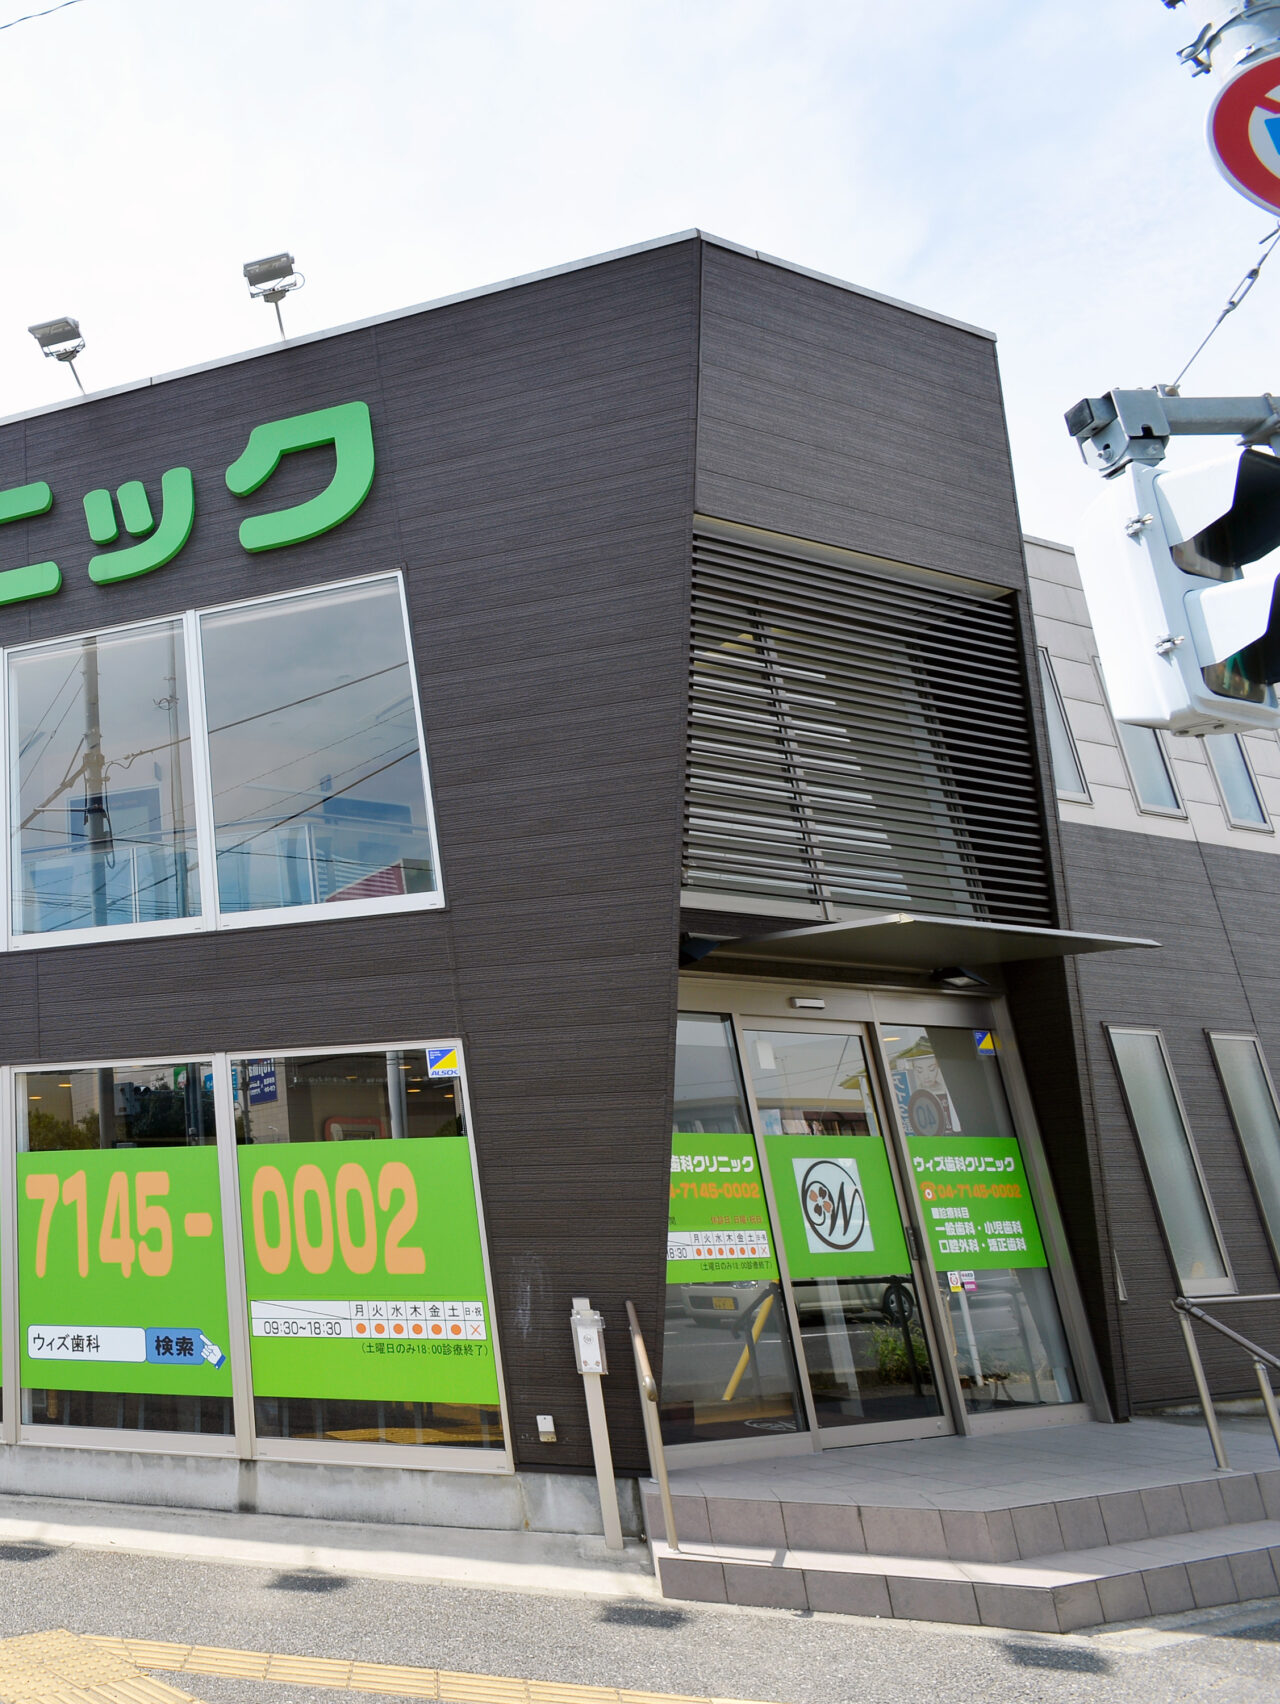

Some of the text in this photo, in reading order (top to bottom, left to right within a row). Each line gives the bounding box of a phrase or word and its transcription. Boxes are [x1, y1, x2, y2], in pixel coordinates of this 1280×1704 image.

[913, 1156, 1015, 1172] ウィズ歯科クリニック
[937, 1183, 1023, 1199] 04-7145-0002
[667, 1247, 688, 1259] 8:30
[354, 1304, 365, 1317] 月
[372, 1304, 384, 1317] 火
[391, 1304, 404, 1317] 水
[409, 1304, 422, 1317] 木
[428, 1304, 441, 1318] 金
[448, 1304, 460, 1318] 土
[32, 1333, 195, 1357] ウィズ歯科 検索
